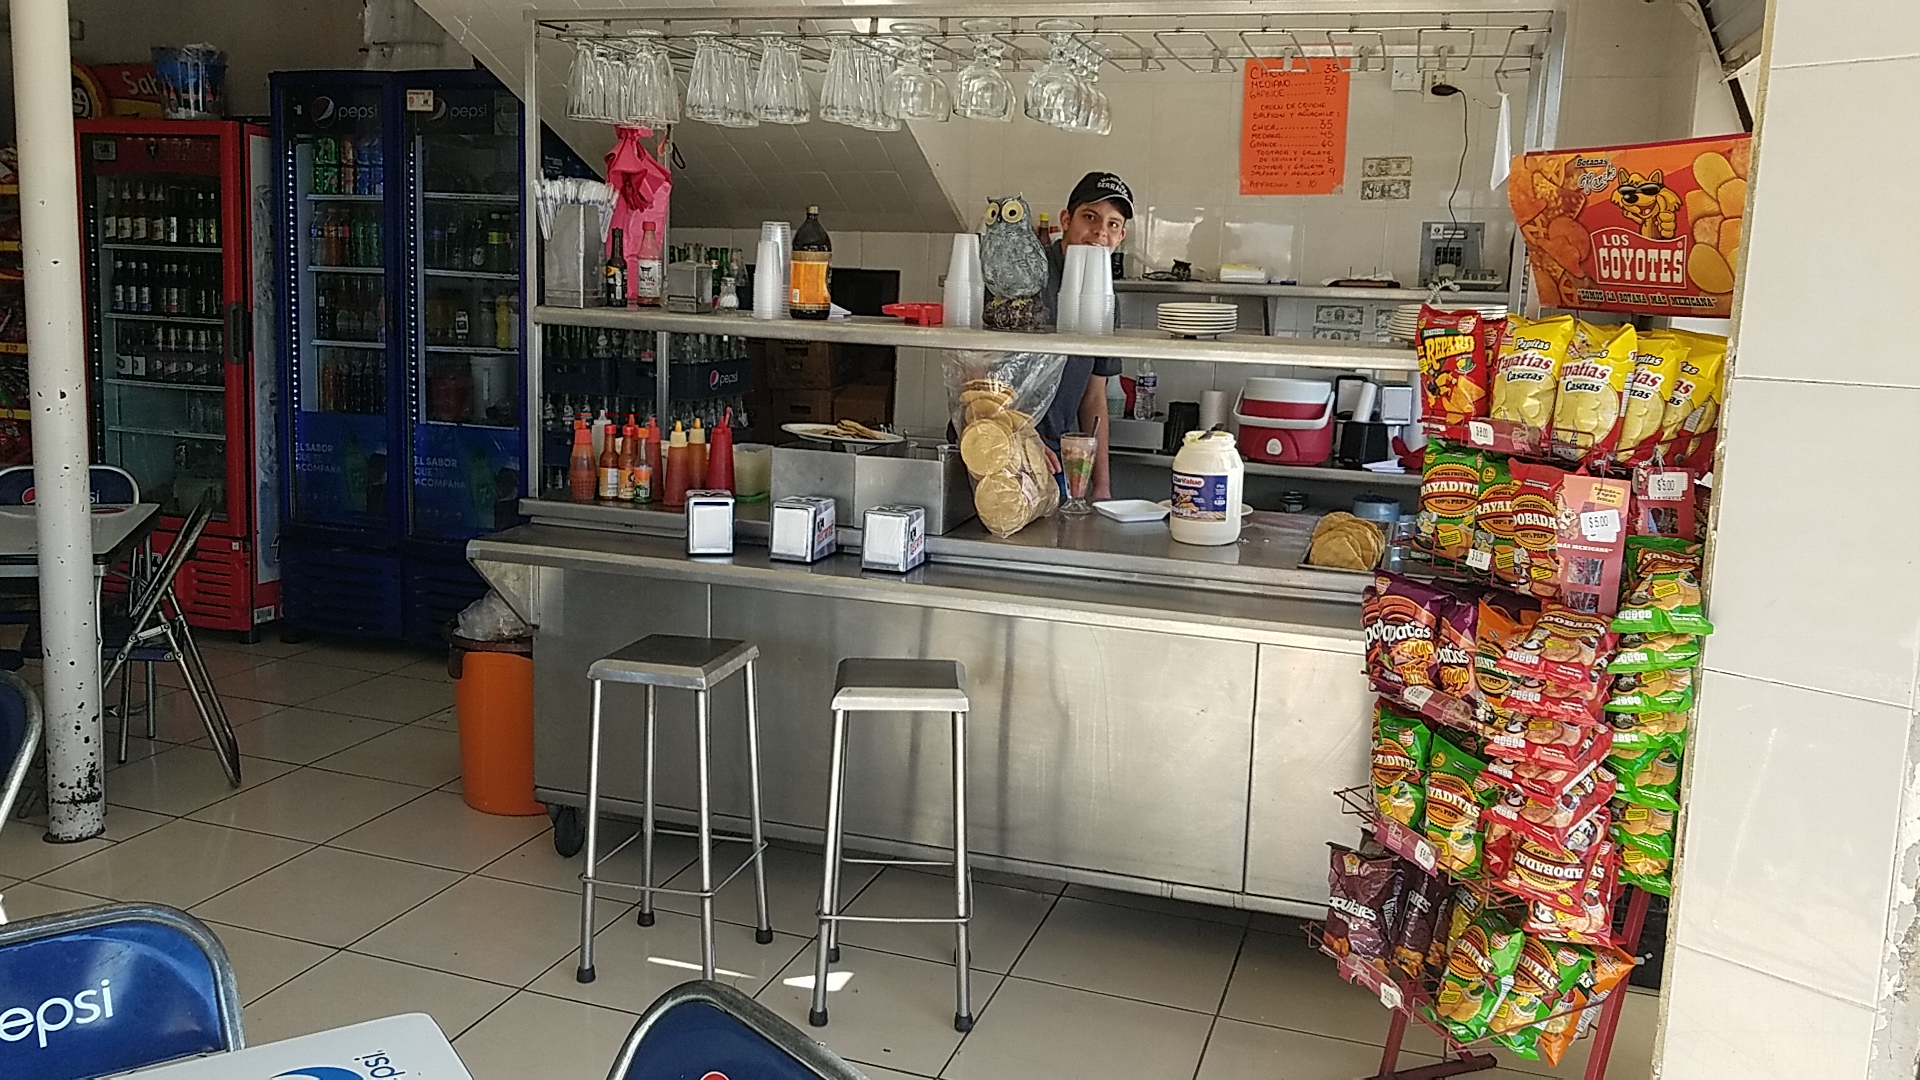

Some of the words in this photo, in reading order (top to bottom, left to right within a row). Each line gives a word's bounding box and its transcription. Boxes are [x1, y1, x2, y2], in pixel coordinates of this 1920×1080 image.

[1324, 64, 1340, 73] 35
[1251, 80, 1291, 89] MEDIANO
[1324, 75, 1339, 85] 50
[1324, 86, 1337, 95] 75
[338, 104, 378, 124] pepsi
[450, 104, 487, 123] pepsi
[1320, 119, 1333, 129] 35
[1320, 131, 1334, 139] 45
[1327, 155, 1335, 164] 8
[1576, 158, 1608, 167] Botanas
[1328, 167, 1336, 176] 9
[1602, 234, 1629, 246] LOS
[1599, 247, 1684, 283] COYOTES
[1606, 290, 1617, 302] LA
[1619, 292, 1648, 304] BOTANA
[1514, 337, 1551, 351] Papitas
[719, 371, 739, 387] pepsi
[1507, 371, 1544, 381] Caseras
[1565, 381, 1602, 392] Caseras
[414, 457, 425, 466] EL
[426, 457, 458, 468] SABOR
[414, 467, 432, 476] QUE
[1514, 851, 1585, 879] ADOBADAS
[0, 979, 113, 1048] epsi
